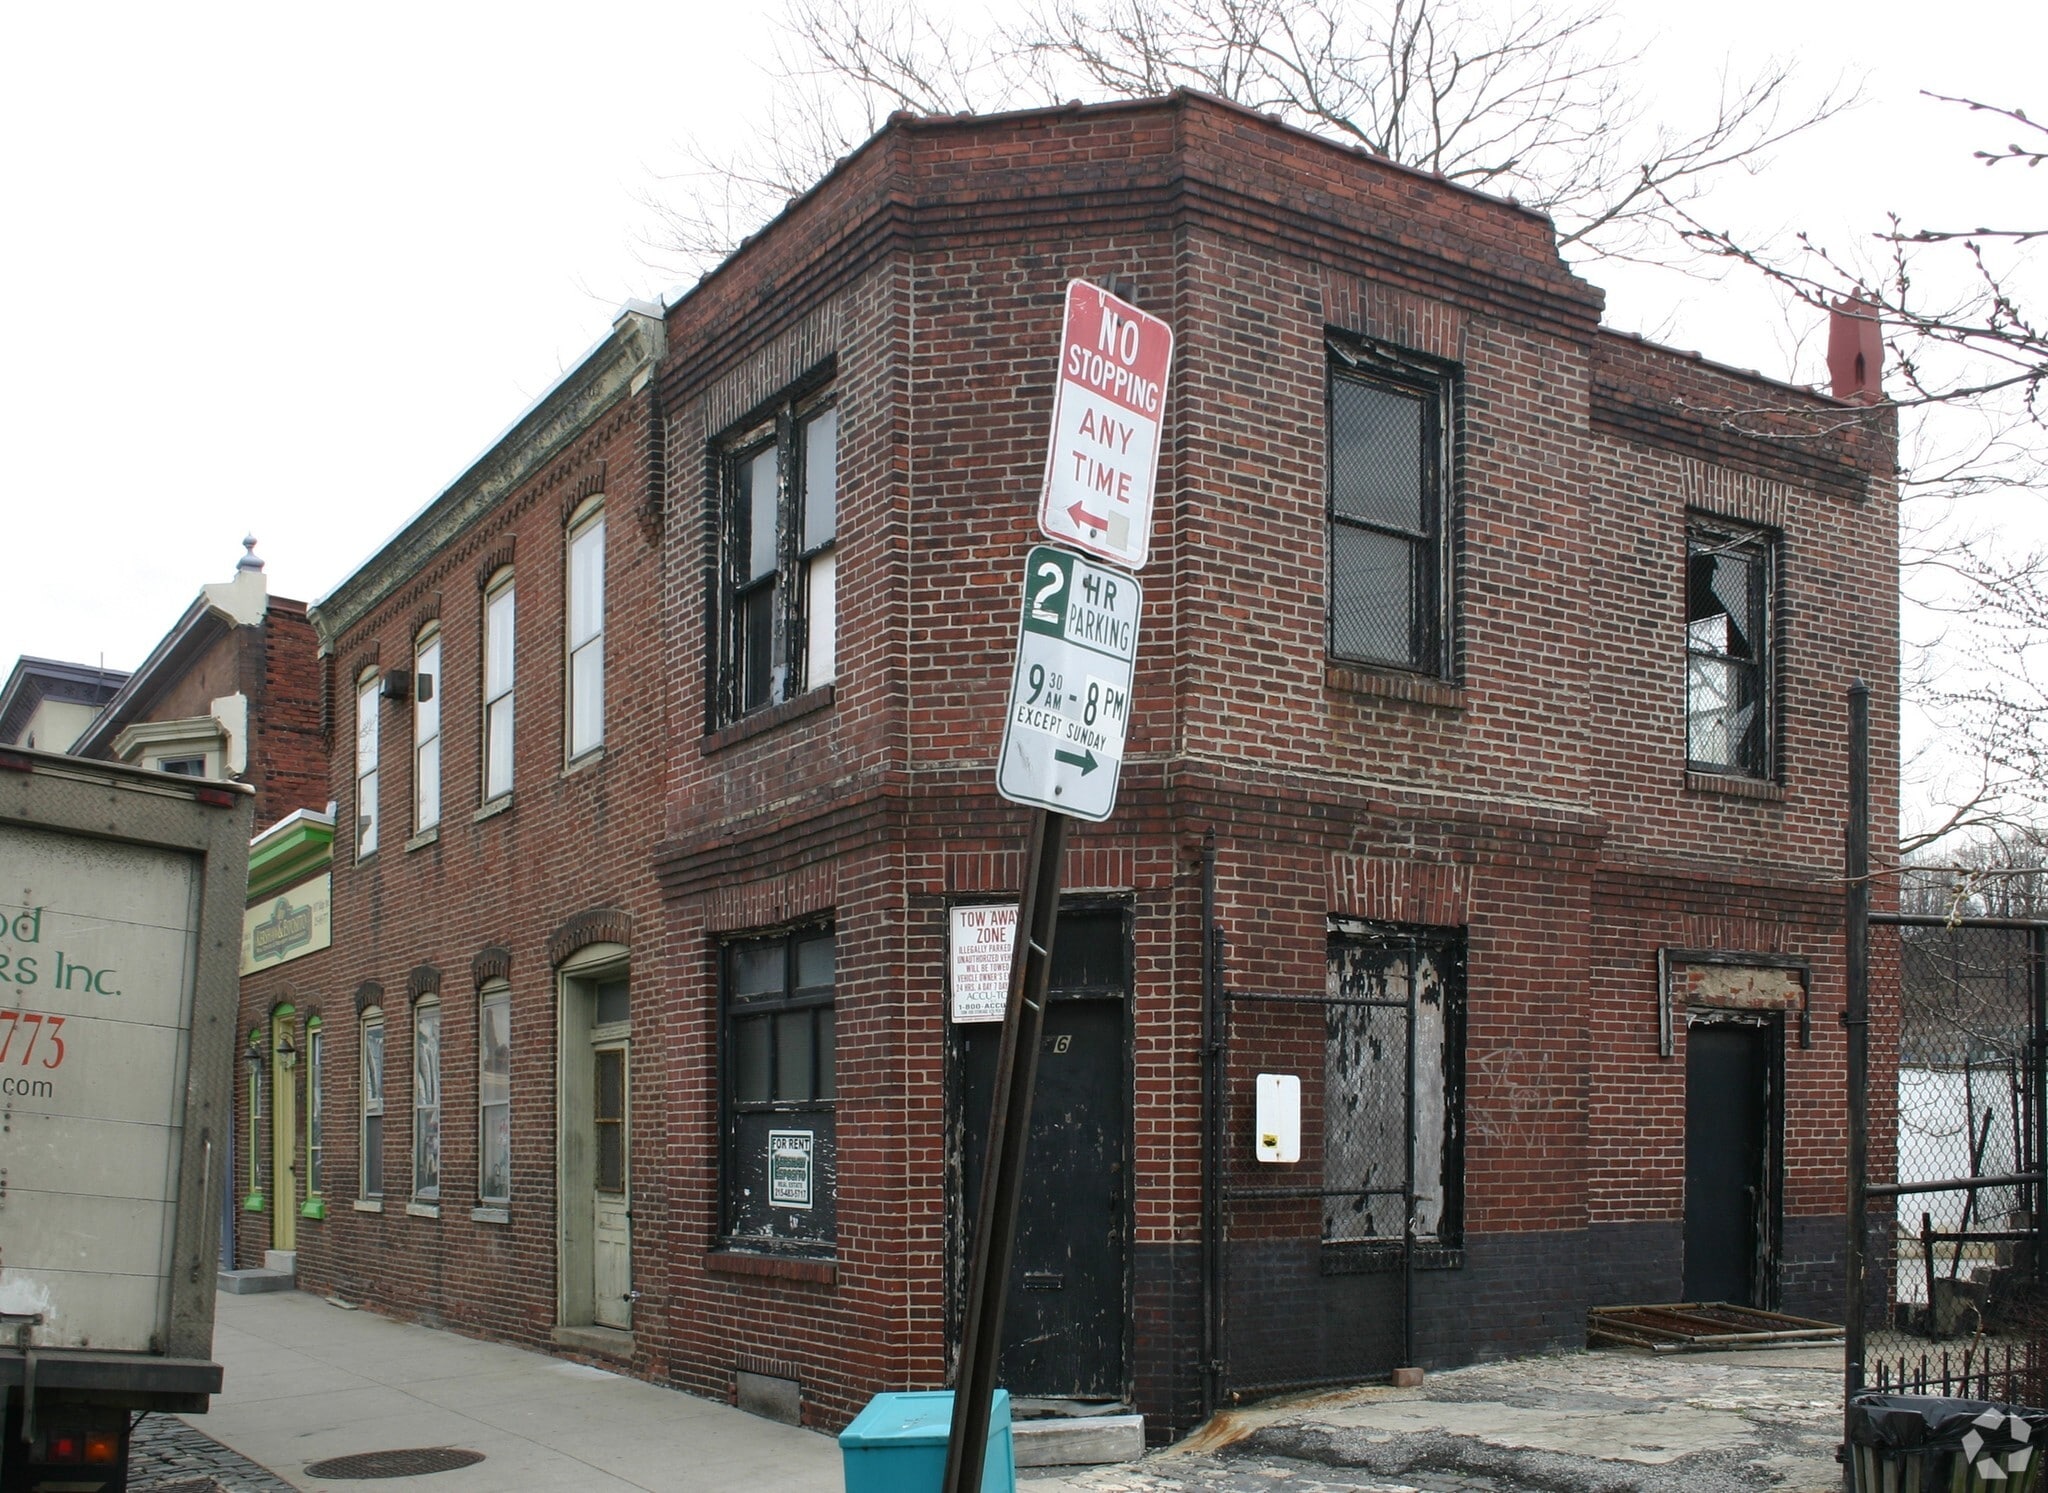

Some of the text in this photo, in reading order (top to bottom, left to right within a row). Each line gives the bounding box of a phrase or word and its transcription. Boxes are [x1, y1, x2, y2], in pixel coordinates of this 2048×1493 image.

[1098, 307, 1139, 366] NO
[1067, 343, 1159, 413] STOPPING
[1078, 408, 1135, 455] ANY
[1072, 450, 1133, 504] TIME
[1031, 562, 1117, 625] 2 HR
[1068, 603, 1130, 652] PARKING
[1026, 663, 1046, 705] 9
[1049, 671, 1064, 691] 30
[1083, 682, 1098, 726] 8
[1103, 687, 1125, 721] PM
[1044, 692, 1063, 711] AM
[1017, 705, 1107, 752] EXCEPT SUNDAY
[960, 911, 986, 928] TOW
[976, 927, 1007, 944] ZONE
[957, 954, 999, 964] UNAUTHORIZED
[958, 943, 1012, 954] ILLEGALLY PARKED
[55, 951, 122, 996] Inc.
[957, 974, 978, 983] VEHICLE
[979, 972, 1003, 982] OWNER'S
[966, 963, 1010, 973] WILL BE TOWED
[956, 983, 963, 992] 24
[978, 983, 982, 991] A
[982, 982, 992, 991] DAY
[993, 981, 998, 991] 7
[0, 1011, 66, 1069] 773
[2, 1077, 53, 1098] com
[772, 1138, 810, 1150] FOR RENT
